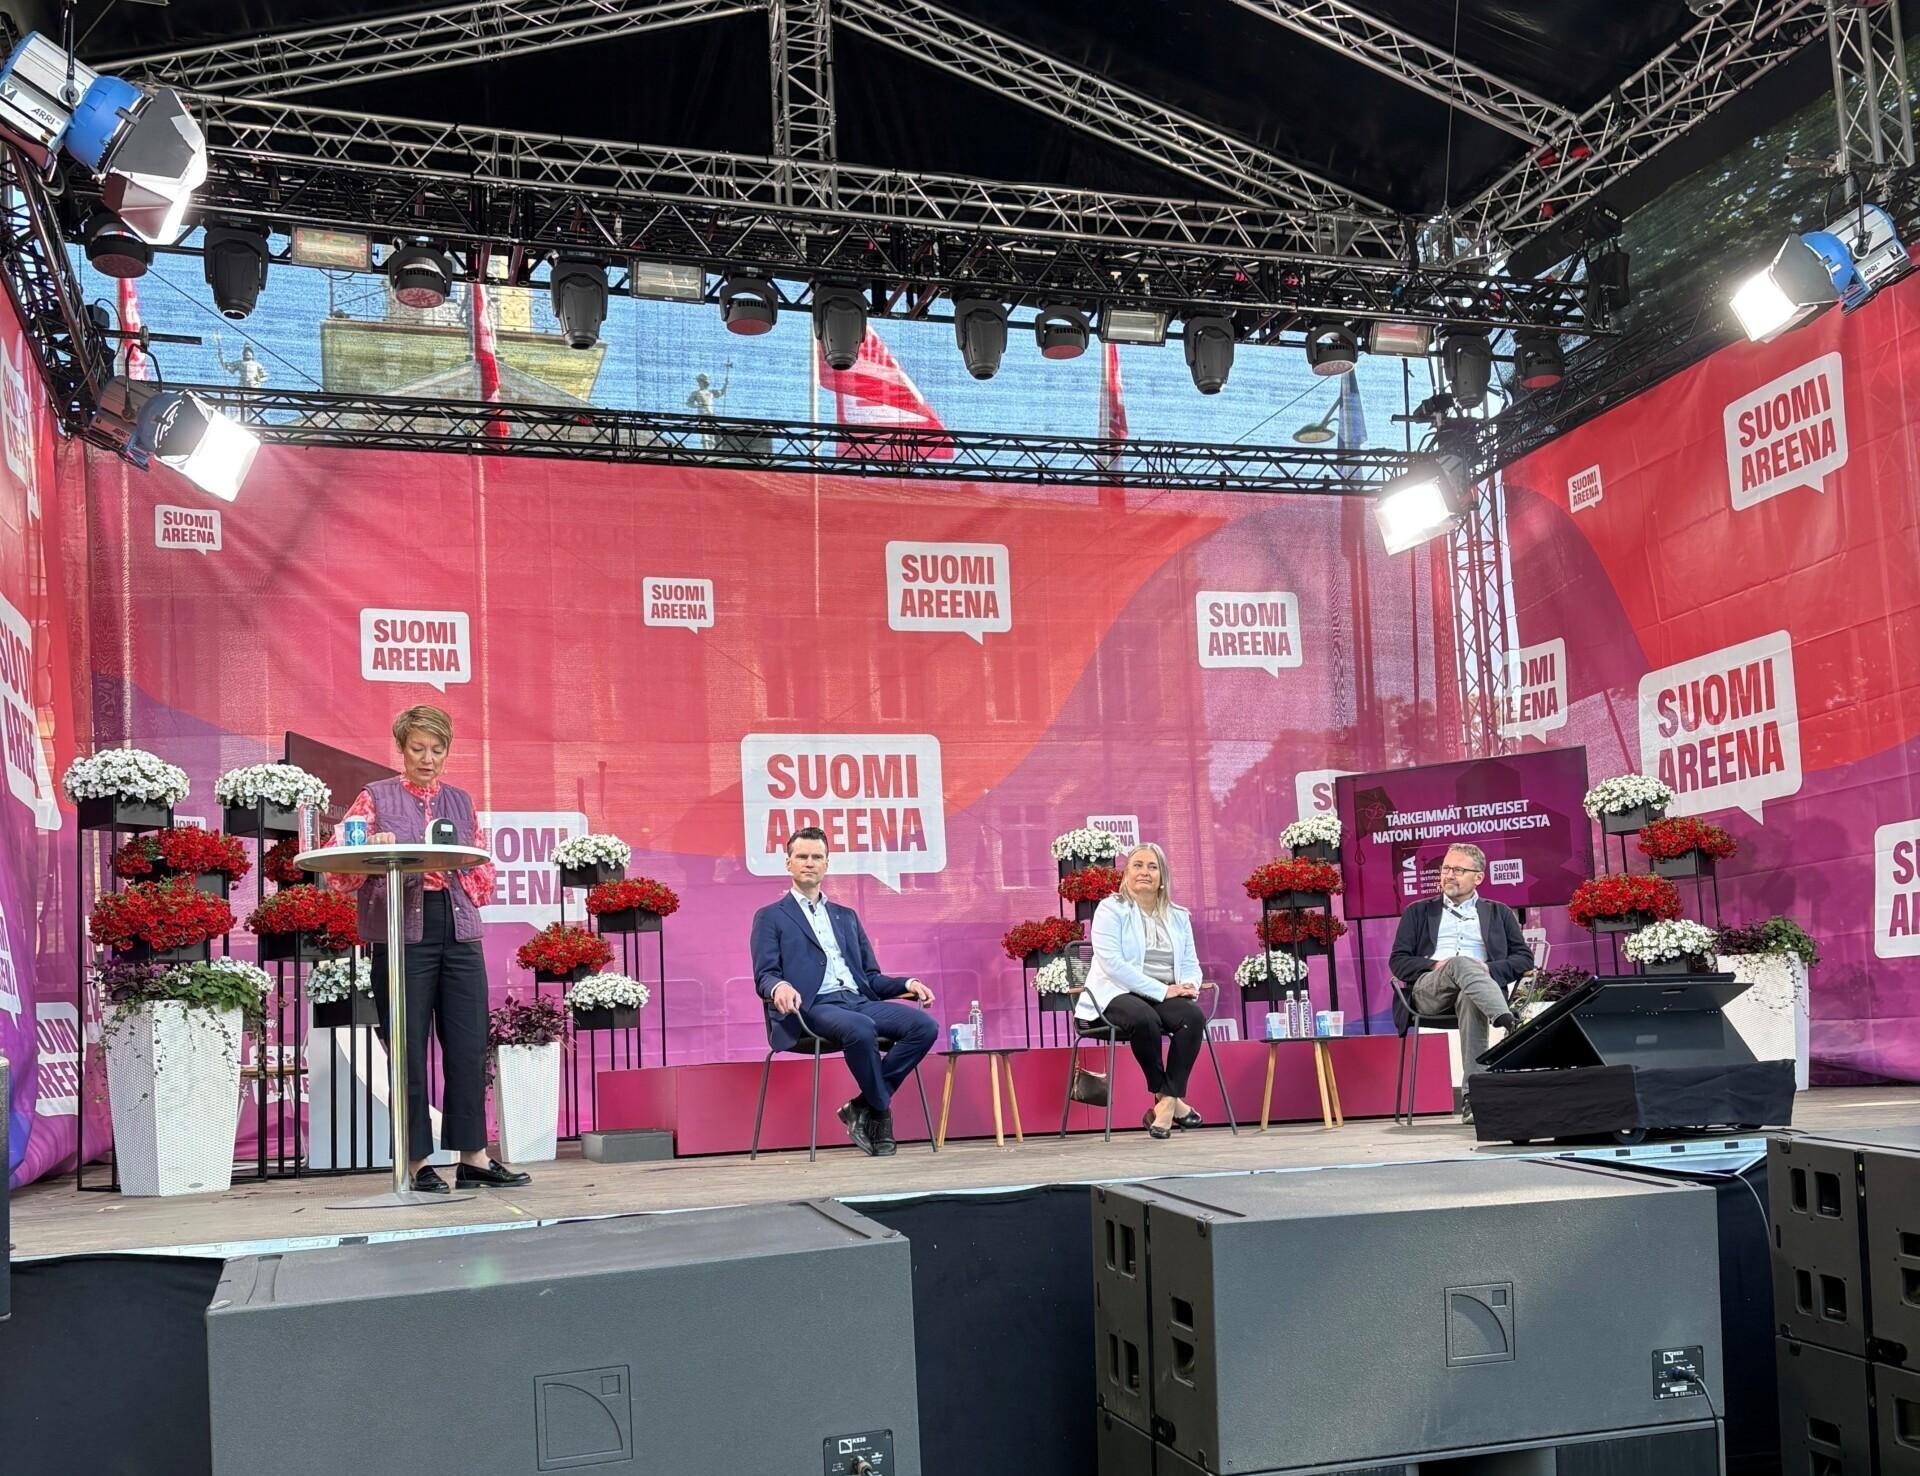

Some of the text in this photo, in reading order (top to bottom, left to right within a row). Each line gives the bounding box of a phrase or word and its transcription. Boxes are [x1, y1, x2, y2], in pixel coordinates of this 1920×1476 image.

[31, 108, 55, 125] ARRI
[1738, 373, 1831, 448] SUOMI
[1741, 417, 1837, 493] AREENA
[1572, 470, 1597, 493] SUOMI
[1573, 484, 1600, 507] AREENA
[163, 510, 213, 530] SUOMI
[161, 527, 216, 545] AREENA
[901, 553, 995, 585] SUOMI
[651, 583, 705, 602] SUOMI
[900, 588, 1000, 619] AREENA
[651, 602, 707, 620] AREENA
[1208, 602, 1288, 627] SUOMI
[373, 619, 457, 644] SUOMI
[1208, 631, 1292, 656] AREENA
[372, 647, 460, 672] AREENA
[1657, 658, 1776, 738] SUOMI
[1658, 720, 1785, 795] AREENA
[767, 753, 919, 800] SUOMI
[1385, 799, 1529, 827] TÄRKEIMMÄT TERVEISET
[1372, 813, 1551, 845] NATON HUIPPUKOKOUKSESTA
[1402, 855, 1418, 896] FIIA
[1493, 861, 1519, 872] SUOMI
[1493, 870, 1521, 881] AREENA
